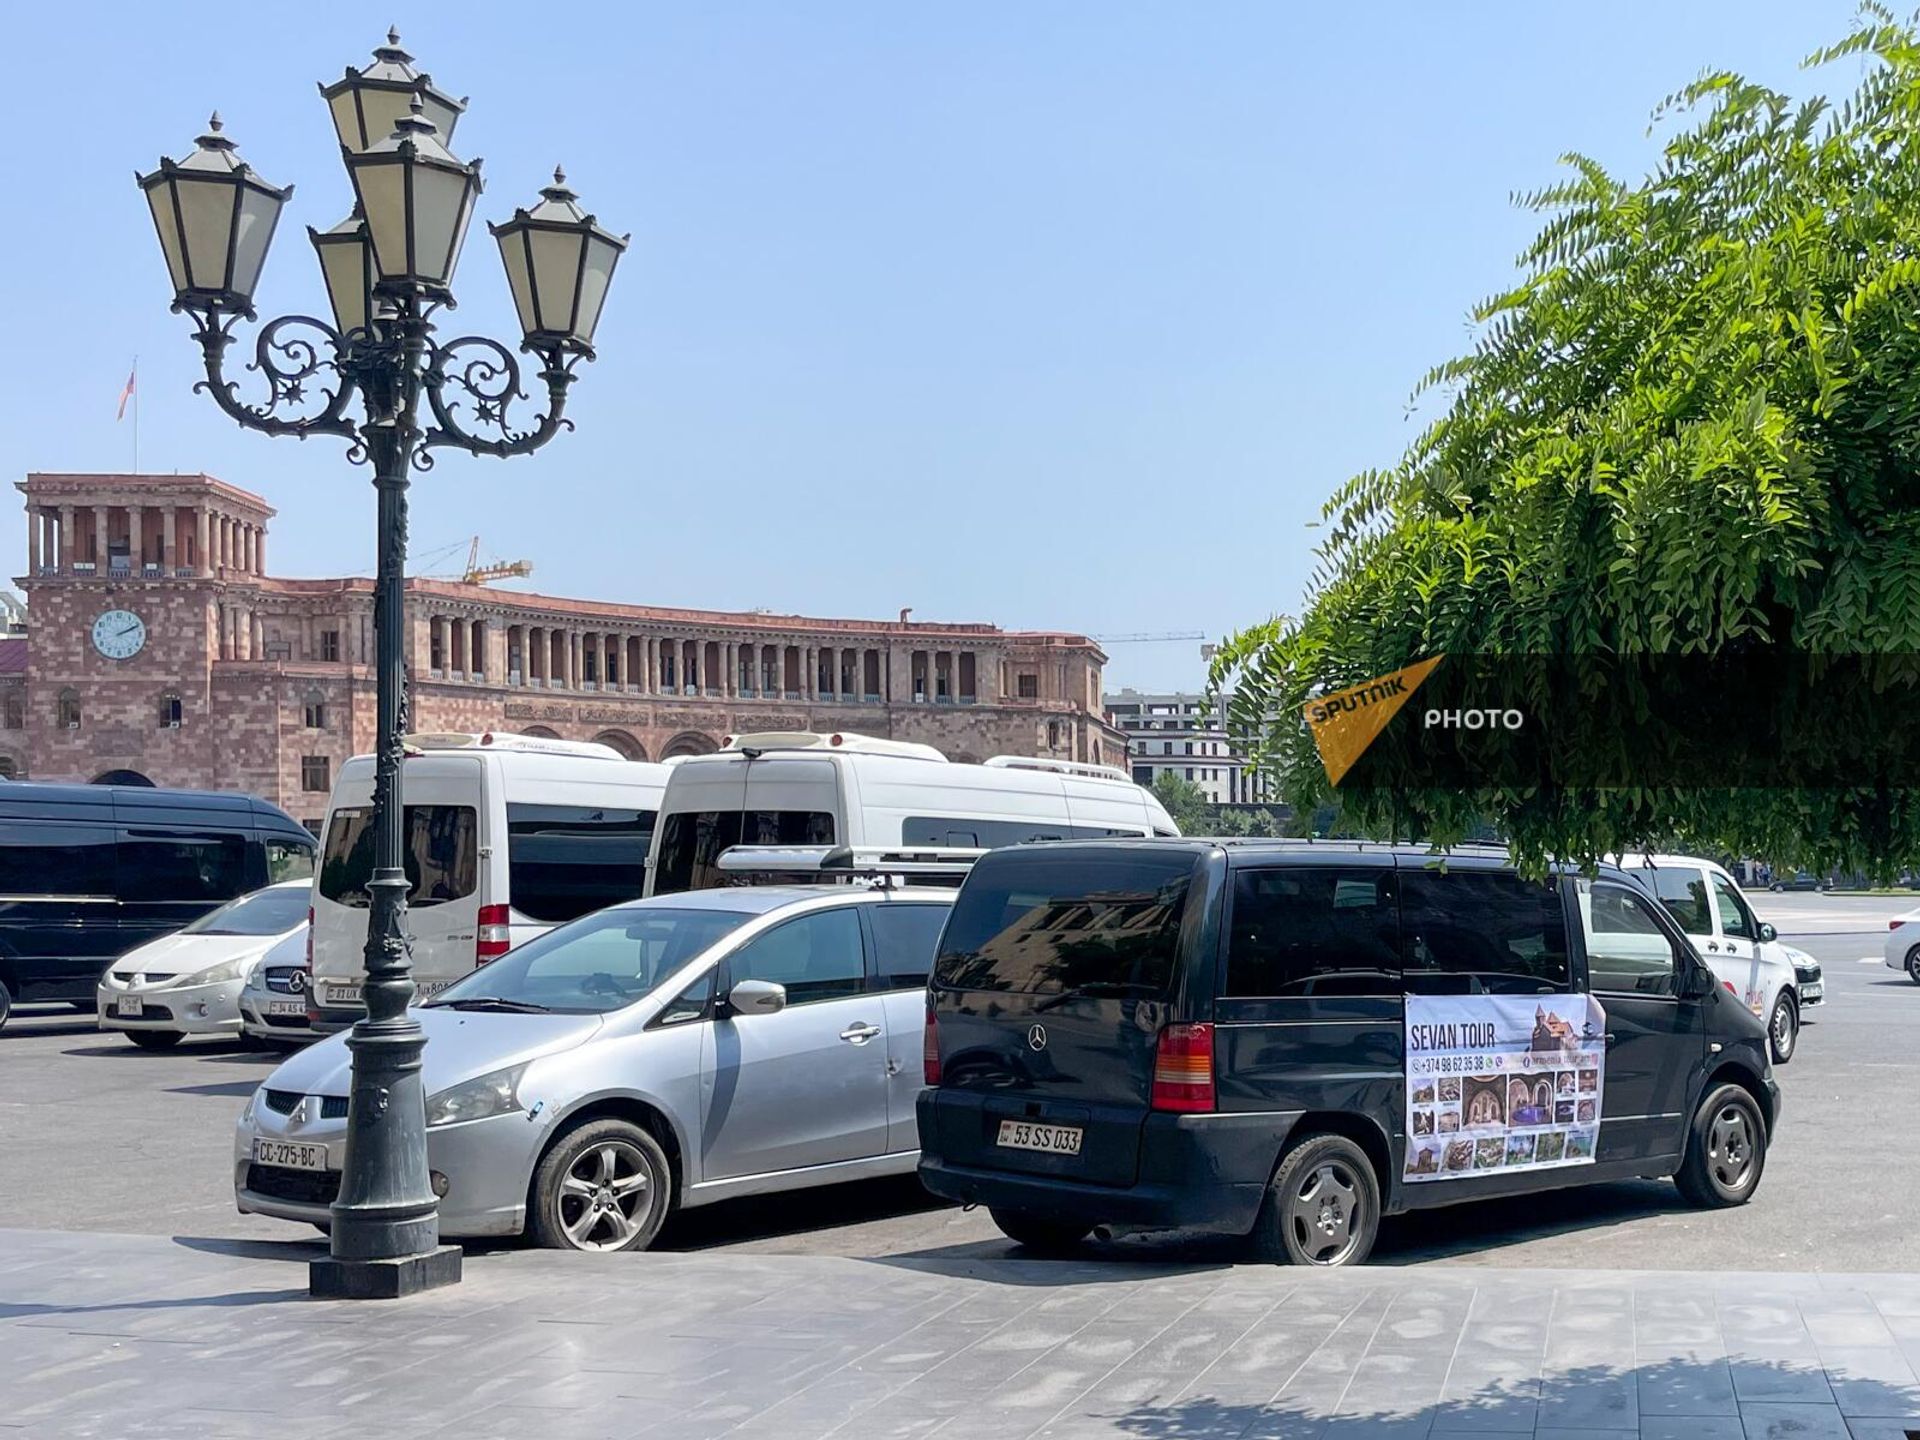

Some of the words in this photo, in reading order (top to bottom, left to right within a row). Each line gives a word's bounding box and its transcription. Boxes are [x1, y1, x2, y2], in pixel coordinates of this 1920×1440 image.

[1411, 1023, 1457, 1051] SEVAN
[1460, 1022, 1495, 1049] TOUR
[1422, 1058, 1440, 1072] +374
[1441, 1057, 1451, 1072] 98
[1453, 1056, 1462, 1071] 62
[1014, 1125, 1031, 1145] 53
[1032, 1127, 1052, 1147] SS
[1053, 1130, 1079, 1150] 033
[260, 1142, 315, 1167] CC-275-BC
